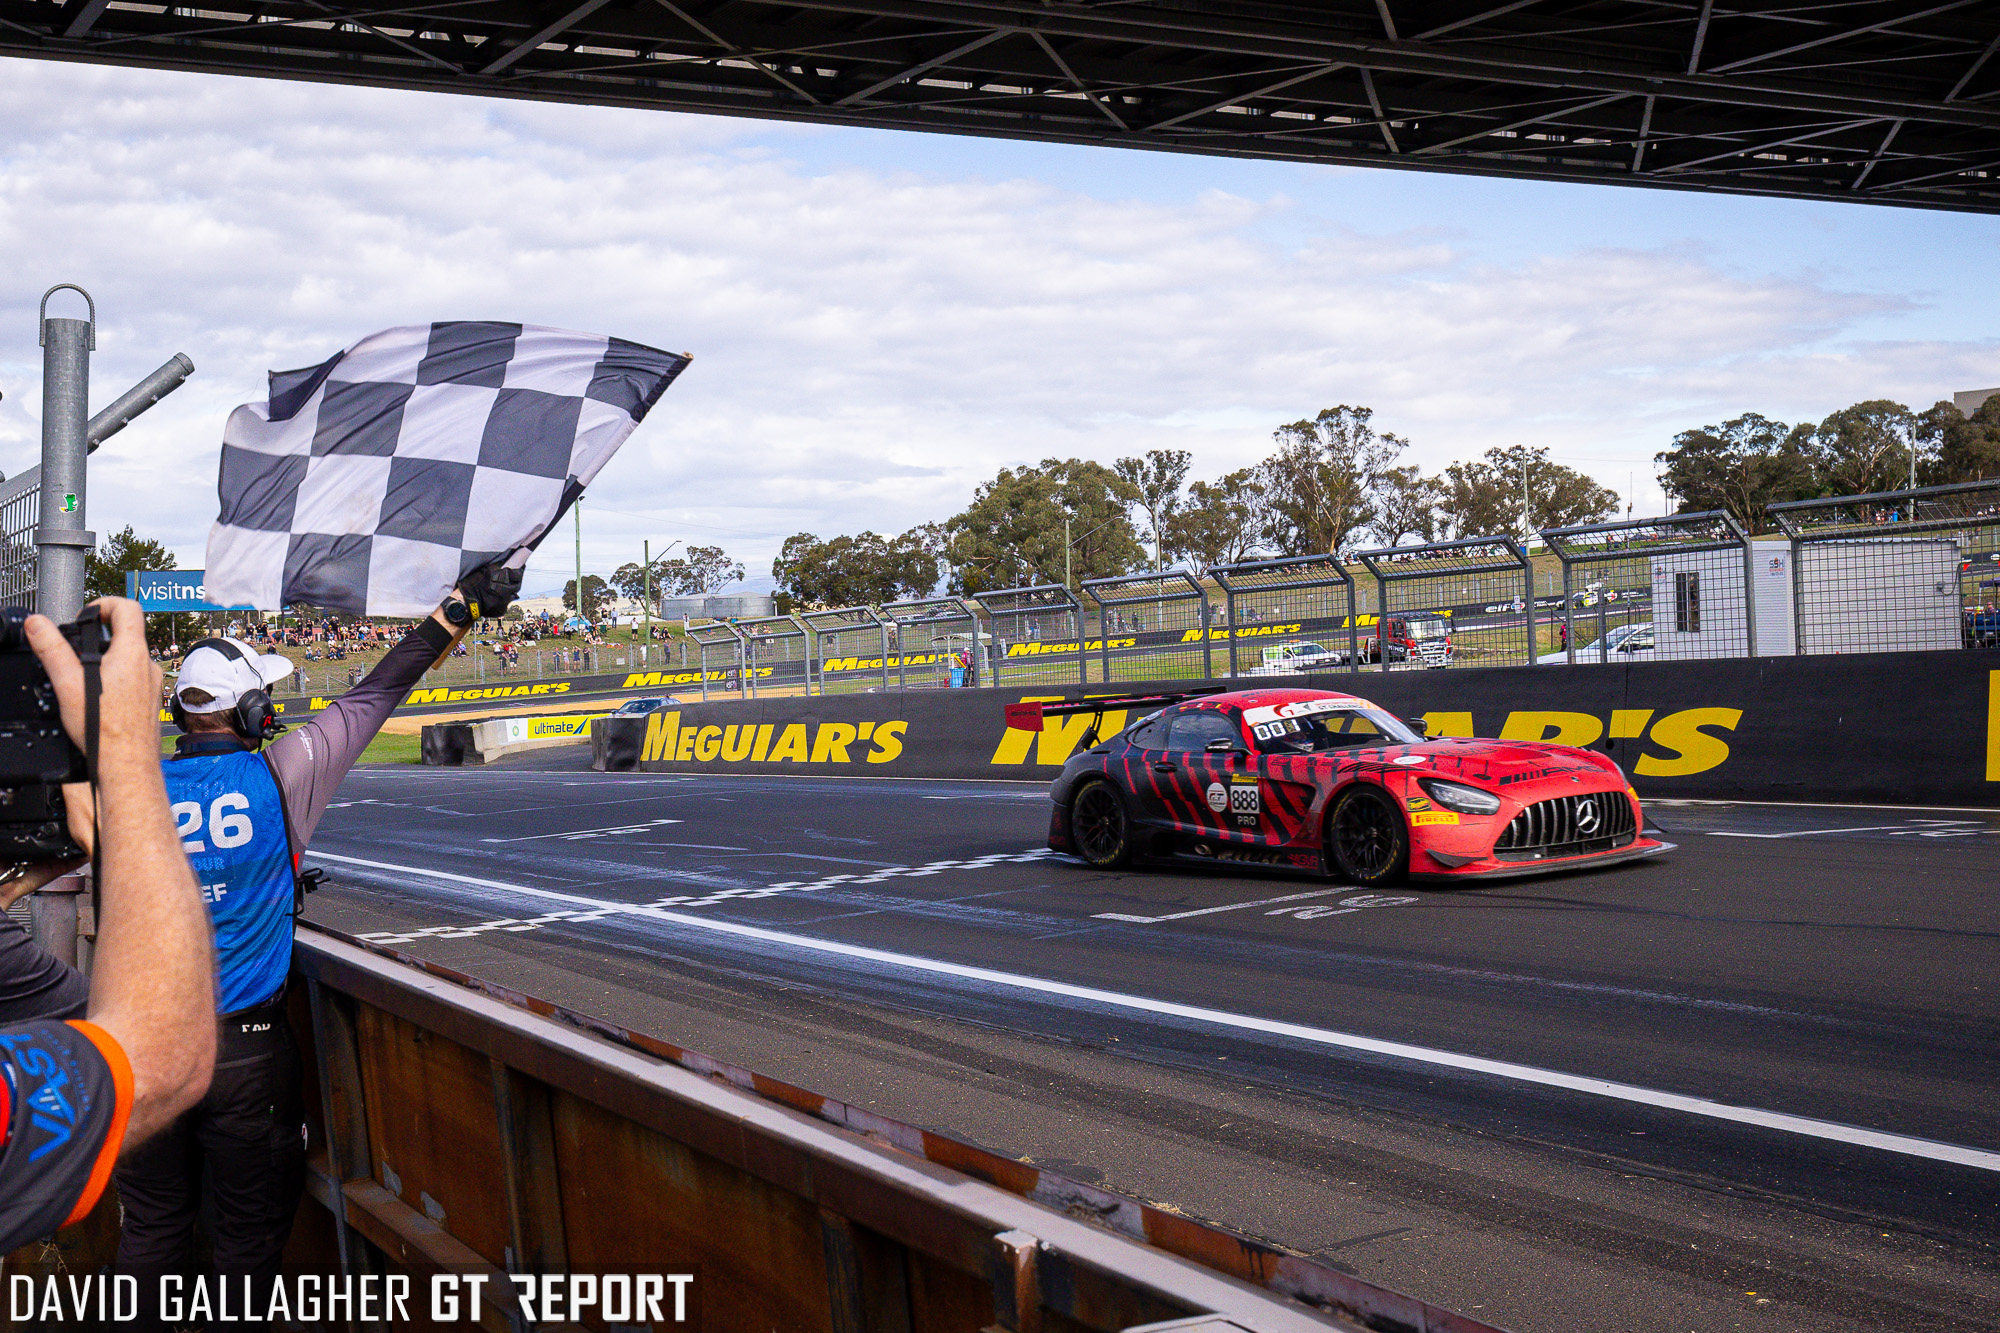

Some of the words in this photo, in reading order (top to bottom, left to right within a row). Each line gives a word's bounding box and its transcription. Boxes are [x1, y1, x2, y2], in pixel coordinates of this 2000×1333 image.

[139, 581, 205, 600] visitns
[406, 682, 571, 704] MEGUIAR'S
[534, 722, 574, 735] ultimate
[641, 711, 908, 763] MEGUIAR'S
[1254, 719, 1301, 740] 001
[1232, 790, 1258, 811] 888
[171, 793, 253, 854] 26
[1237, 816, 1256, 826] PRO
